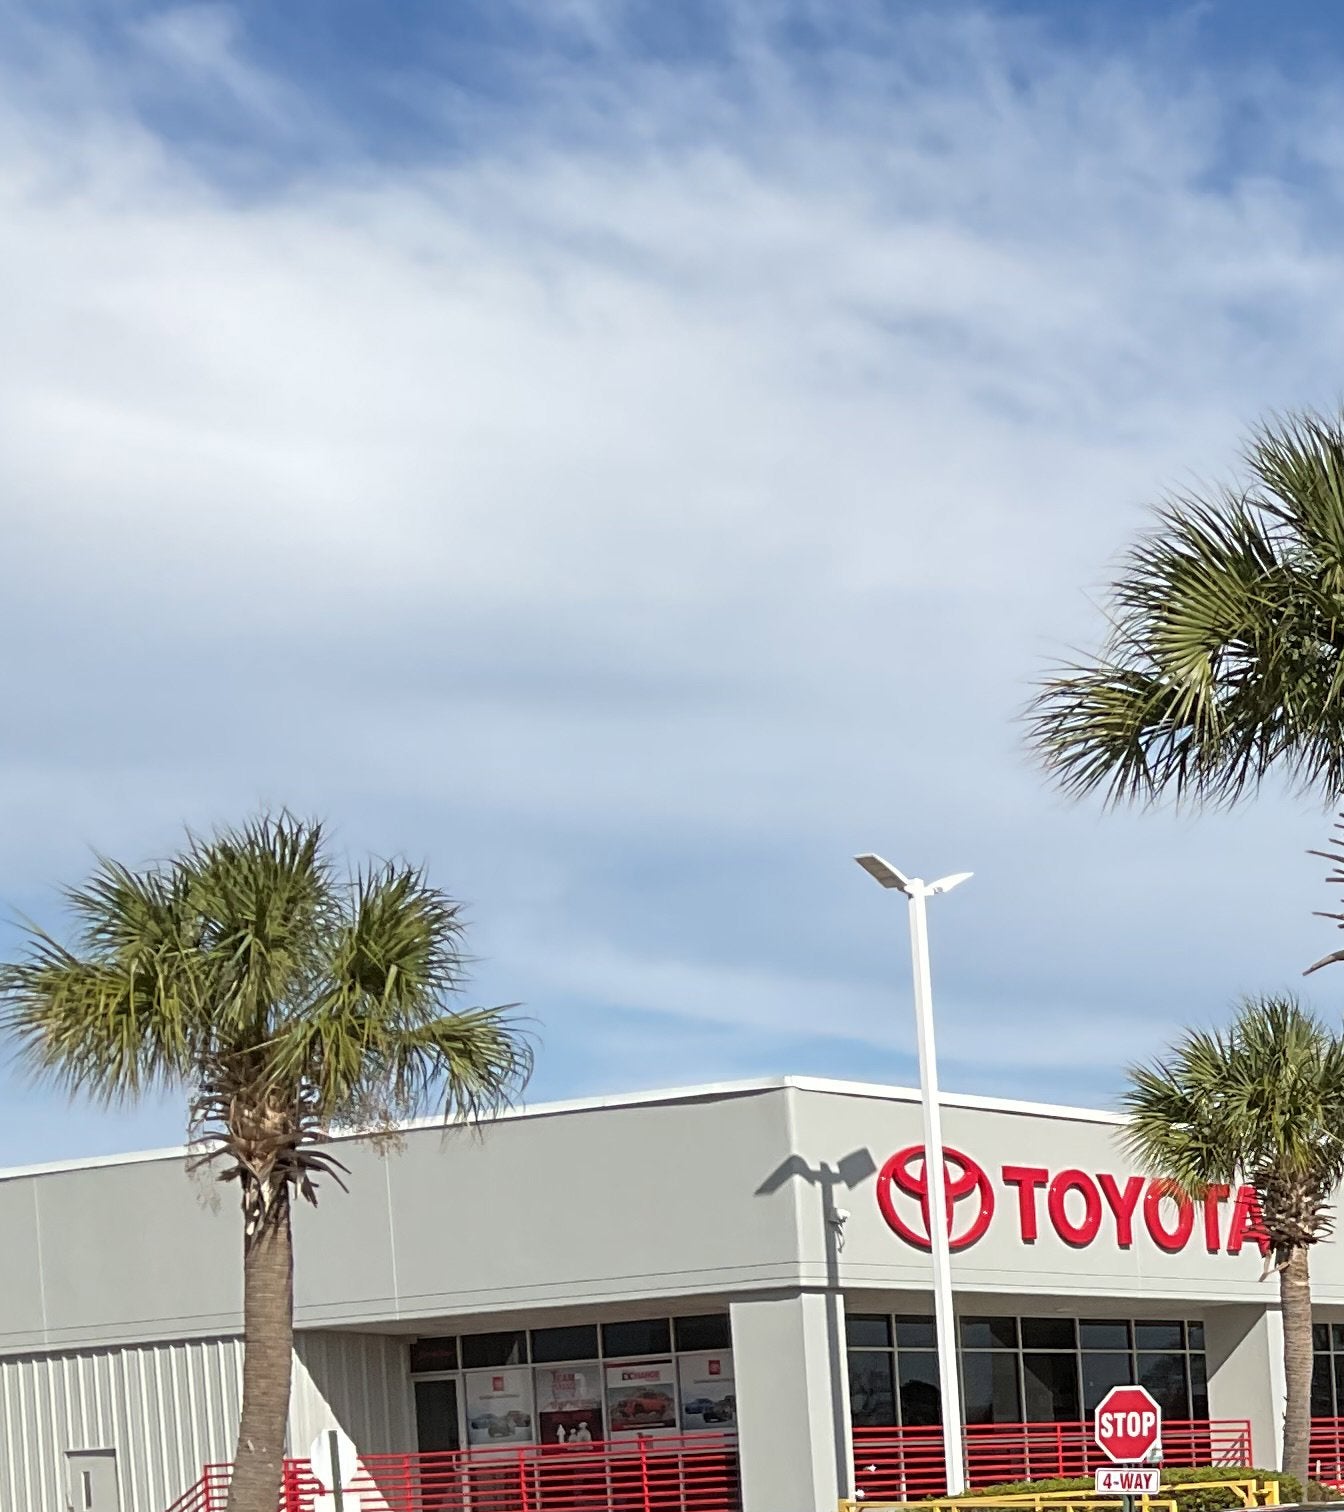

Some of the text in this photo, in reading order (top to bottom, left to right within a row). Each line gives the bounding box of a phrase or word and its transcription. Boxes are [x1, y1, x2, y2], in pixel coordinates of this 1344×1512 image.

[1002, 1165, 1272, 1257] TOYOTA
[1101, 1411, 1155, 1438] STOP
[1103, 1473, 1152, 1489] 4-WAY
